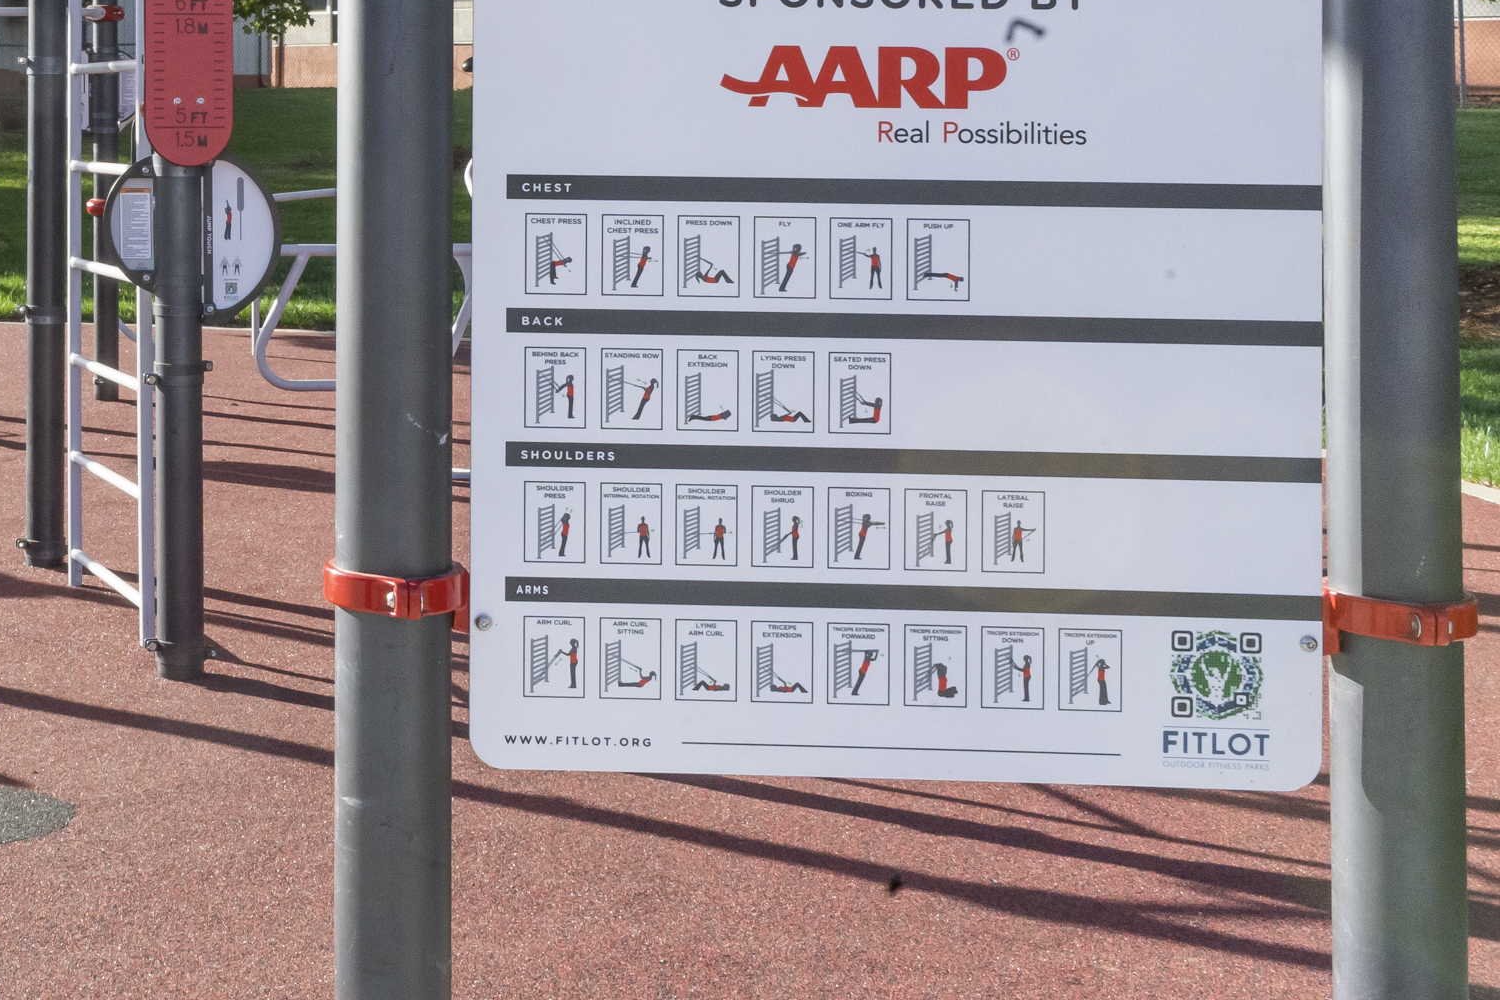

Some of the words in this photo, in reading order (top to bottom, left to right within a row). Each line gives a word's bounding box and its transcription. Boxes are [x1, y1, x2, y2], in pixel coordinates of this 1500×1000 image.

[191, 0, 207, 10] FT
[176, 19, 195, 34] 1.8
[198, 23, 208, 34] M
[176, 108, 186, 123] 5
[191, 112, 207, 123] FT
[176, 131, 195, 146] 1.5
[198, 136, 207, 147] M
[878, 122, 930, 144] Real
[942, 122, 1086, 146] Possibilities
[522, 183, 572, 192] CHEST
[522, 316, 563, 326] BACK
[521, 450, 616, 461] SHOULDERS
[516, 585, 549, 595] ARMS
[504, 734, 653, 747] WWW.FITLOT.ORG
[1163, 730, 1269, 756] FITLOT
[1163, 760, 1205, 769] OUTDOOR
[1209, 761, 1242, 770] FITNESS
[1245, 762, 1269, 770] PARKS
